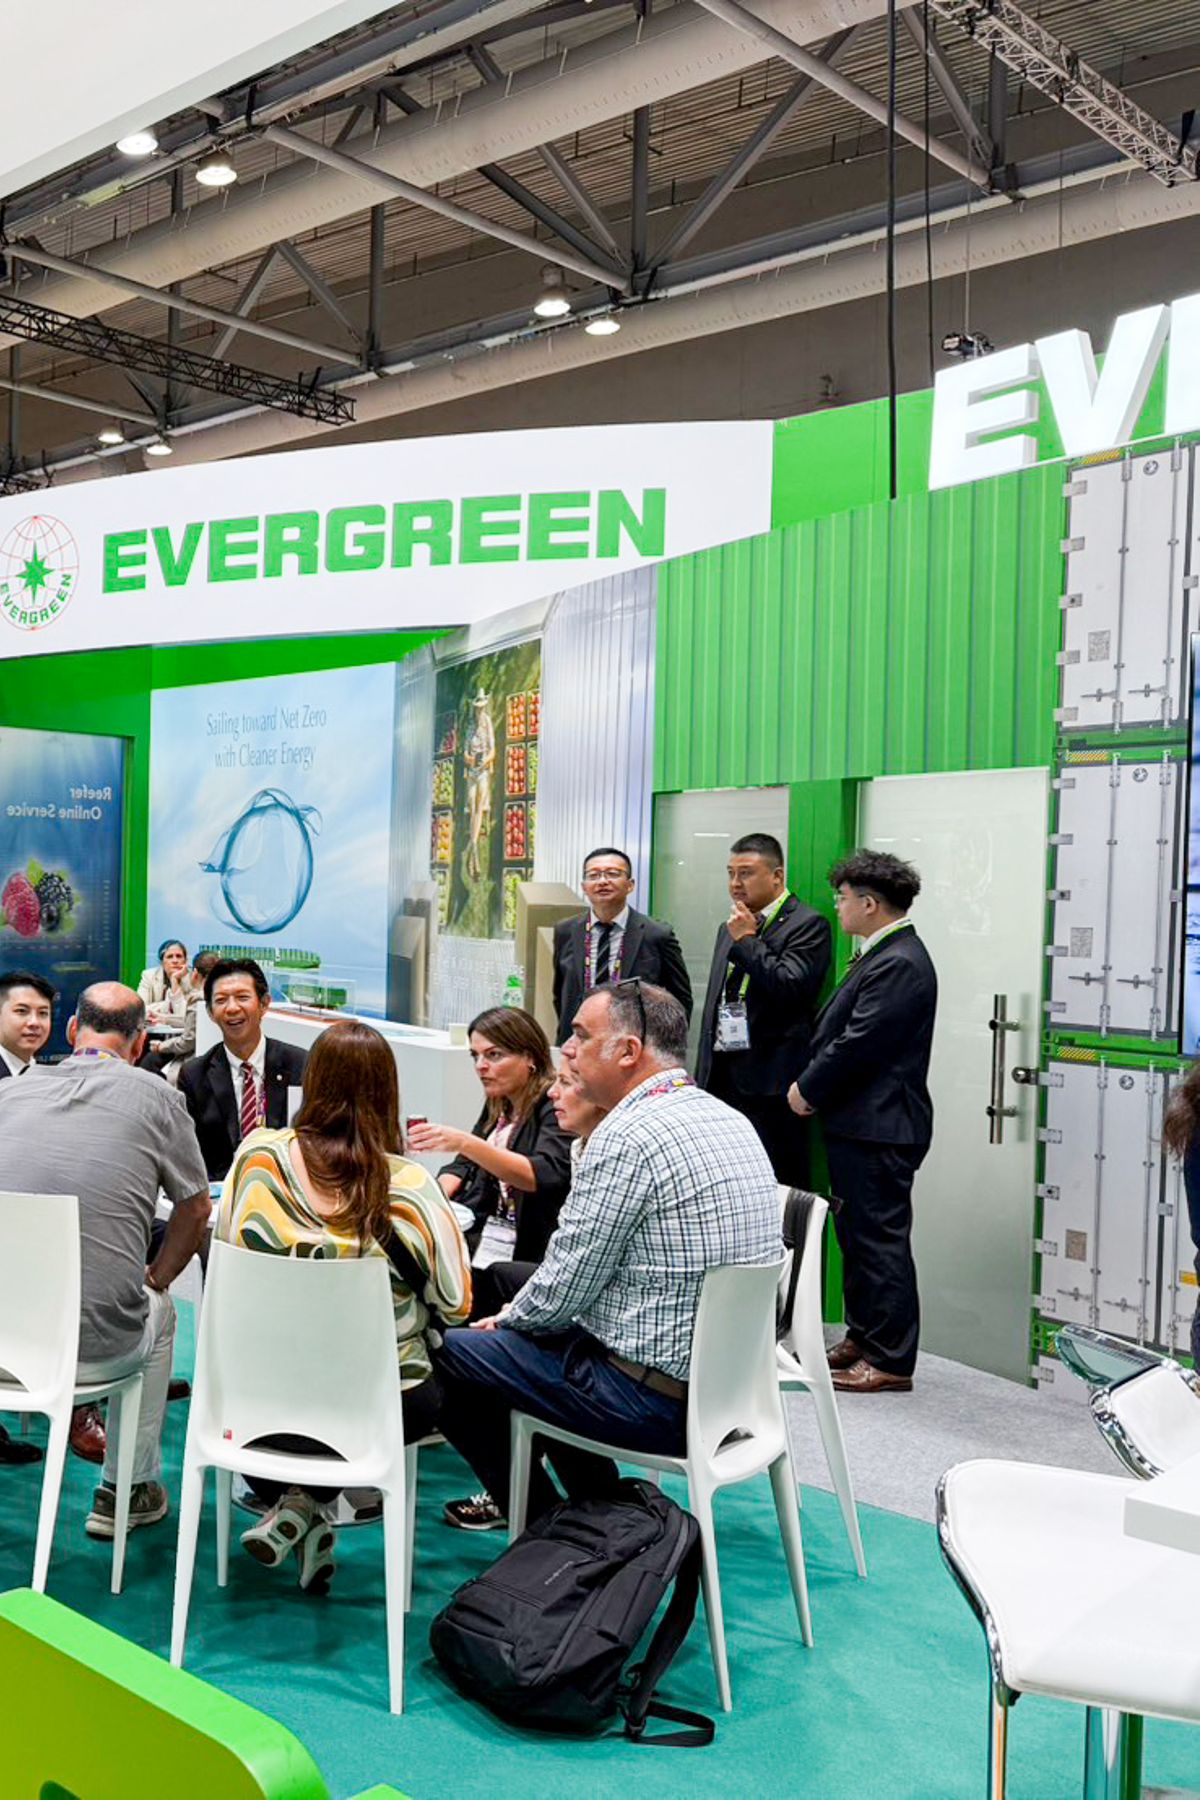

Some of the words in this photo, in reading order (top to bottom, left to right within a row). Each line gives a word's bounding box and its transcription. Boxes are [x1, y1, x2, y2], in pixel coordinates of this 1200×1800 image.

[928, 294, 1200, 491] EV
[102, 487, 667, 593] EVERGREEN
[0, 574, 72, 624] EVERGREEN
[206, 712, 240, 741] Sailing
[242, 706, 277, 733] toward
[280, 707, 299, 729] Net
[302, 704, 328, 728] Zero
[214, 744, 235, 768] with
[239, 743, 277, 767] Cleaner
[281, 741, 317, 771] Energy
